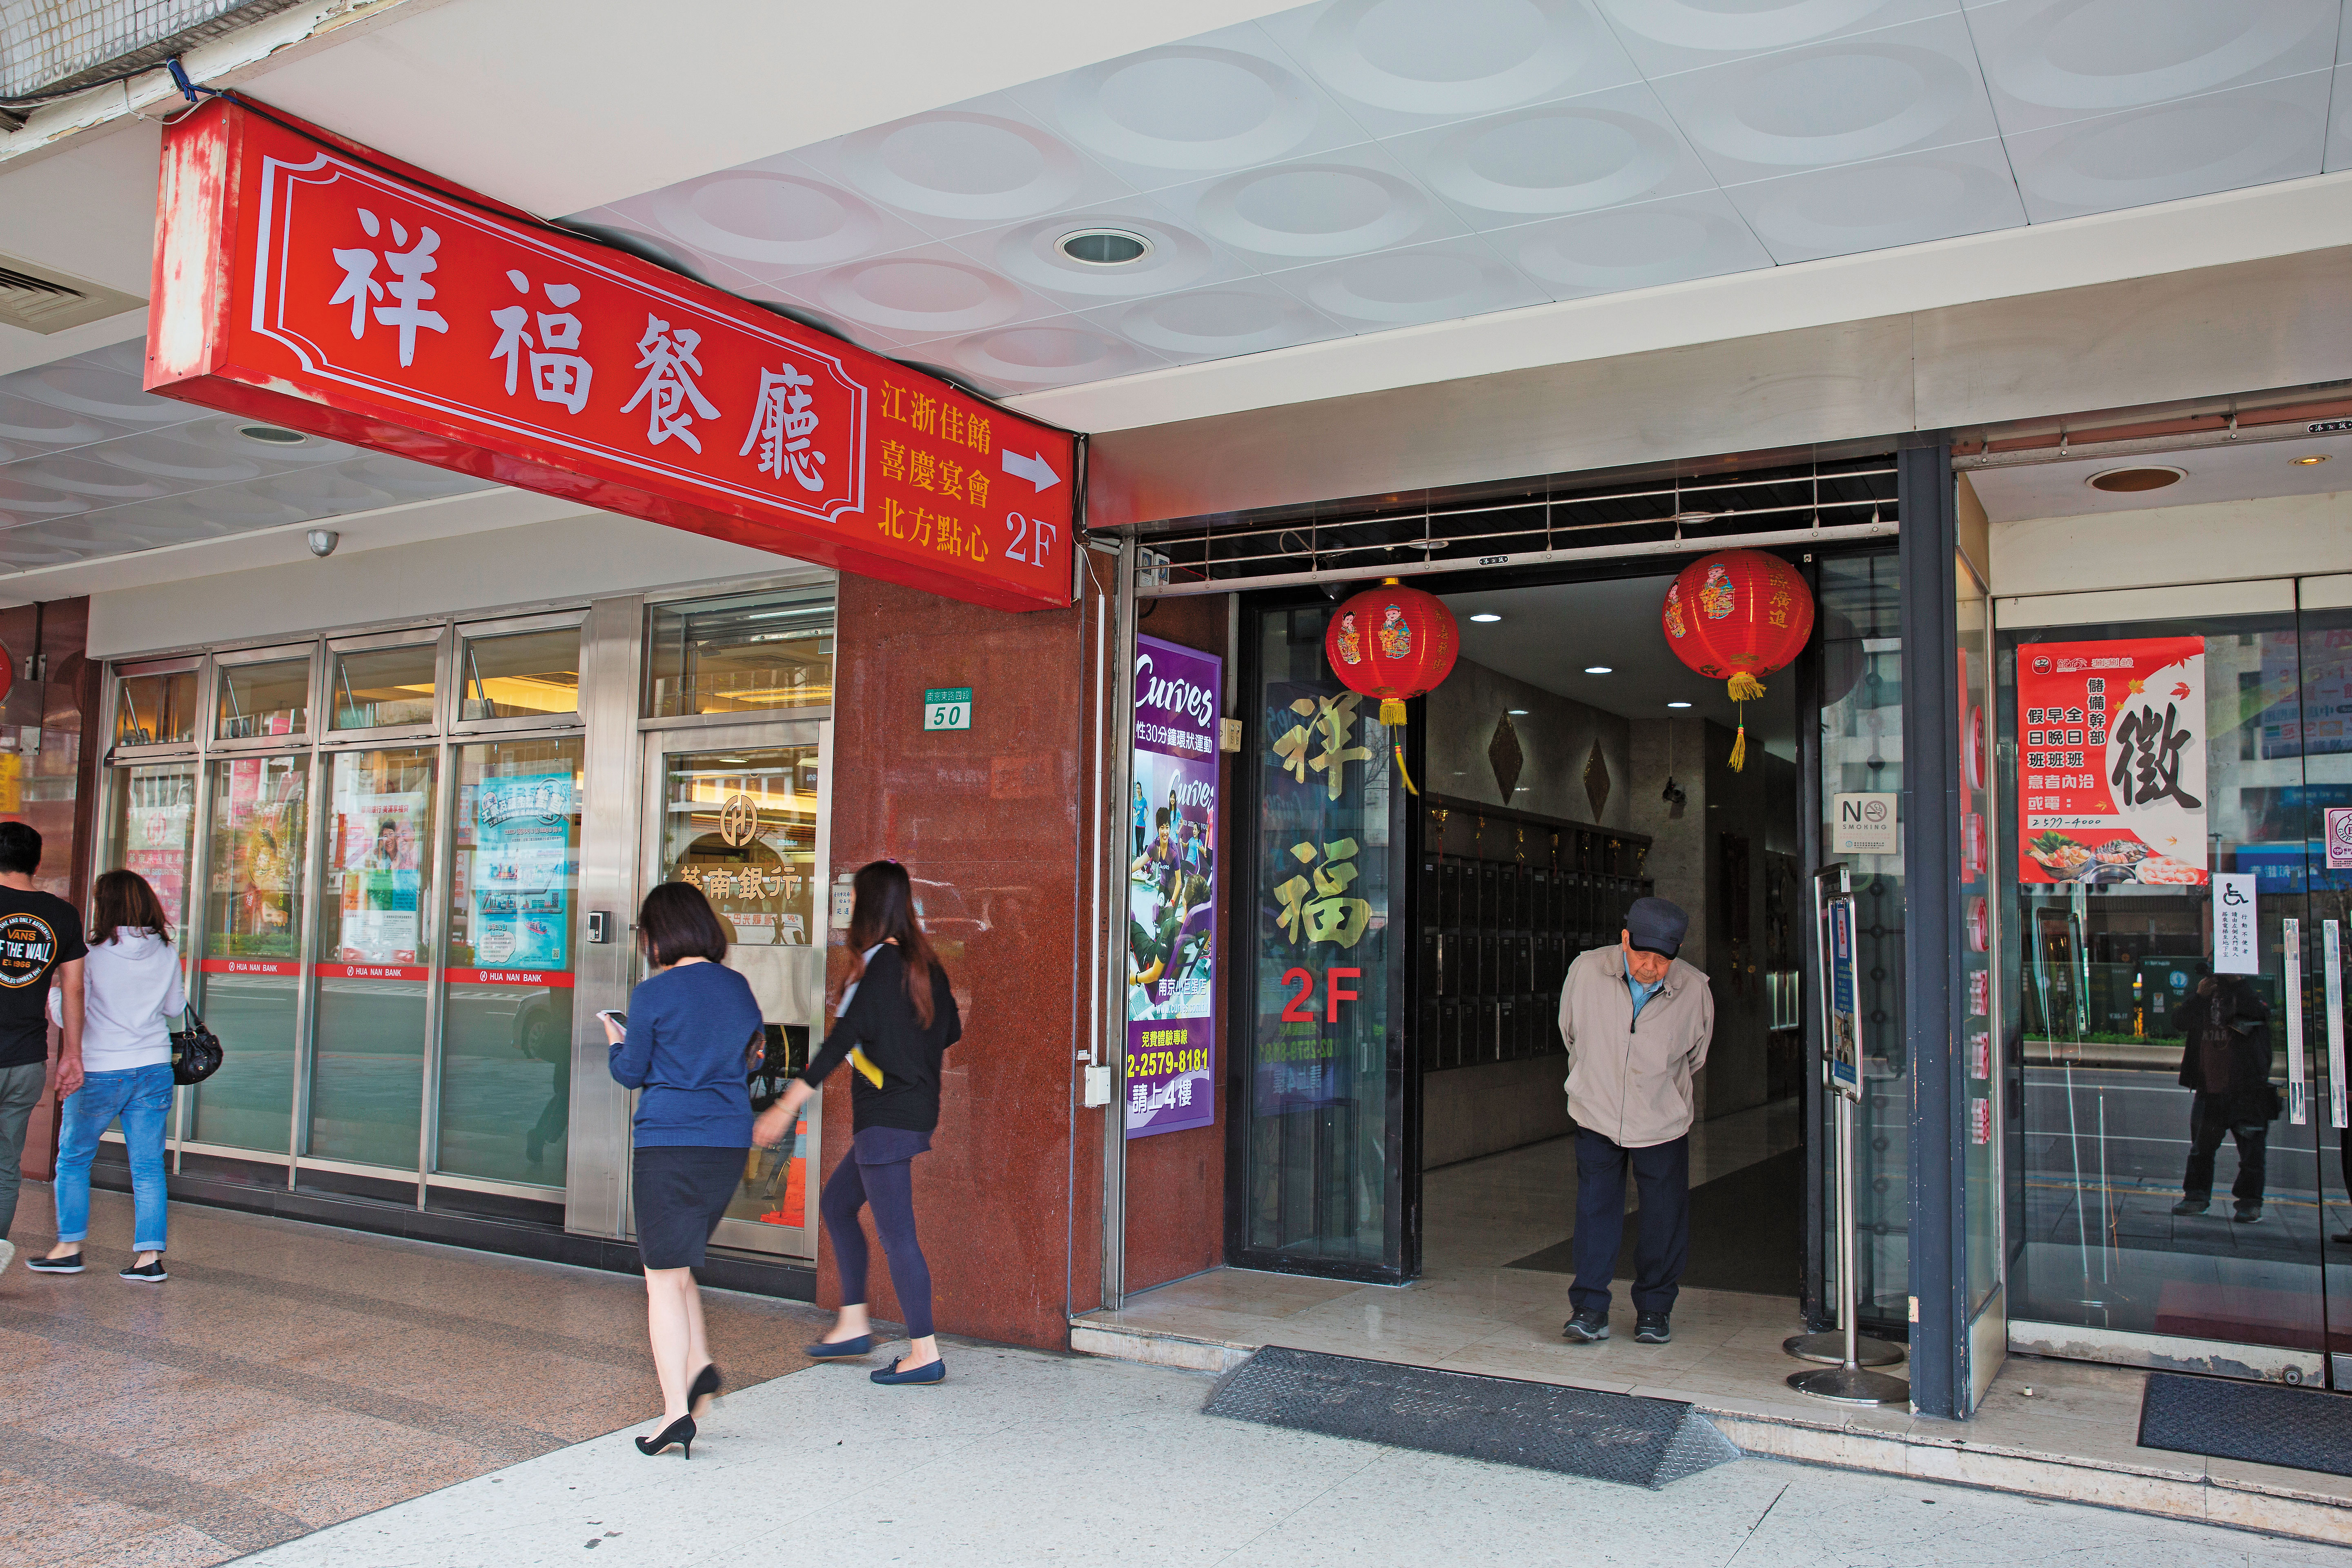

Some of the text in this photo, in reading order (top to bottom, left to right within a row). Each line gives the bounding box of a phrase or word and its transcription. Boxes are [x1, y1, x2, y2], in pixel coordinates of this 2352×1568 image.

[329, 207, 826, 493] 祥福餐廳
[881, 379, 991, 454] 江浙佳餚
[880, 440, 990, 508] 喜慶宴會
[878, 497, 989, 562] 北方點心
[1005, 512, 1056, 568] 2F
[927, 690, 969, 702] 南京東路四段
[1136, 654, 1212, 727] Curves
[934, 706, 960, 725] 50
[2087, 678, 2106, 746] 儲備幹部
[1135, 720, 1212, 754] 性30分鐘環狀運動
[2028, 708, 2044, 768] 假日班
[2047, 708, 2065, 768] 早晚班
[2065, 708, 2084, 768] 全日班
[2112, 702, 2201, 808] 徵
[2028, 774, 2094, 790] 意者內洽
[1273, 690, 1372, 949] 祥福
[2028, 796, 2071, 811] 或電：
[2032, 817, 2101, 827] 2577-4000
[681, 865, 799, 900] 華南銀行
[7, 929, 37, 941] VANS
[7, 941, 24, 958] THE
[25, 943, 51, 962] WALL
[523, 974, 542, 982] BANK
[1158, 978, 1207, 996] 南京小巨蛋店
[1281, 967, 1361, 1023] 2F
[1156, 1003, 1208, 1015] www.curves.com.tw
[1141, 1029, 1188, 1048] 免費體驗專線
[1132, 1078, 1192, 1114] 請上4樓
